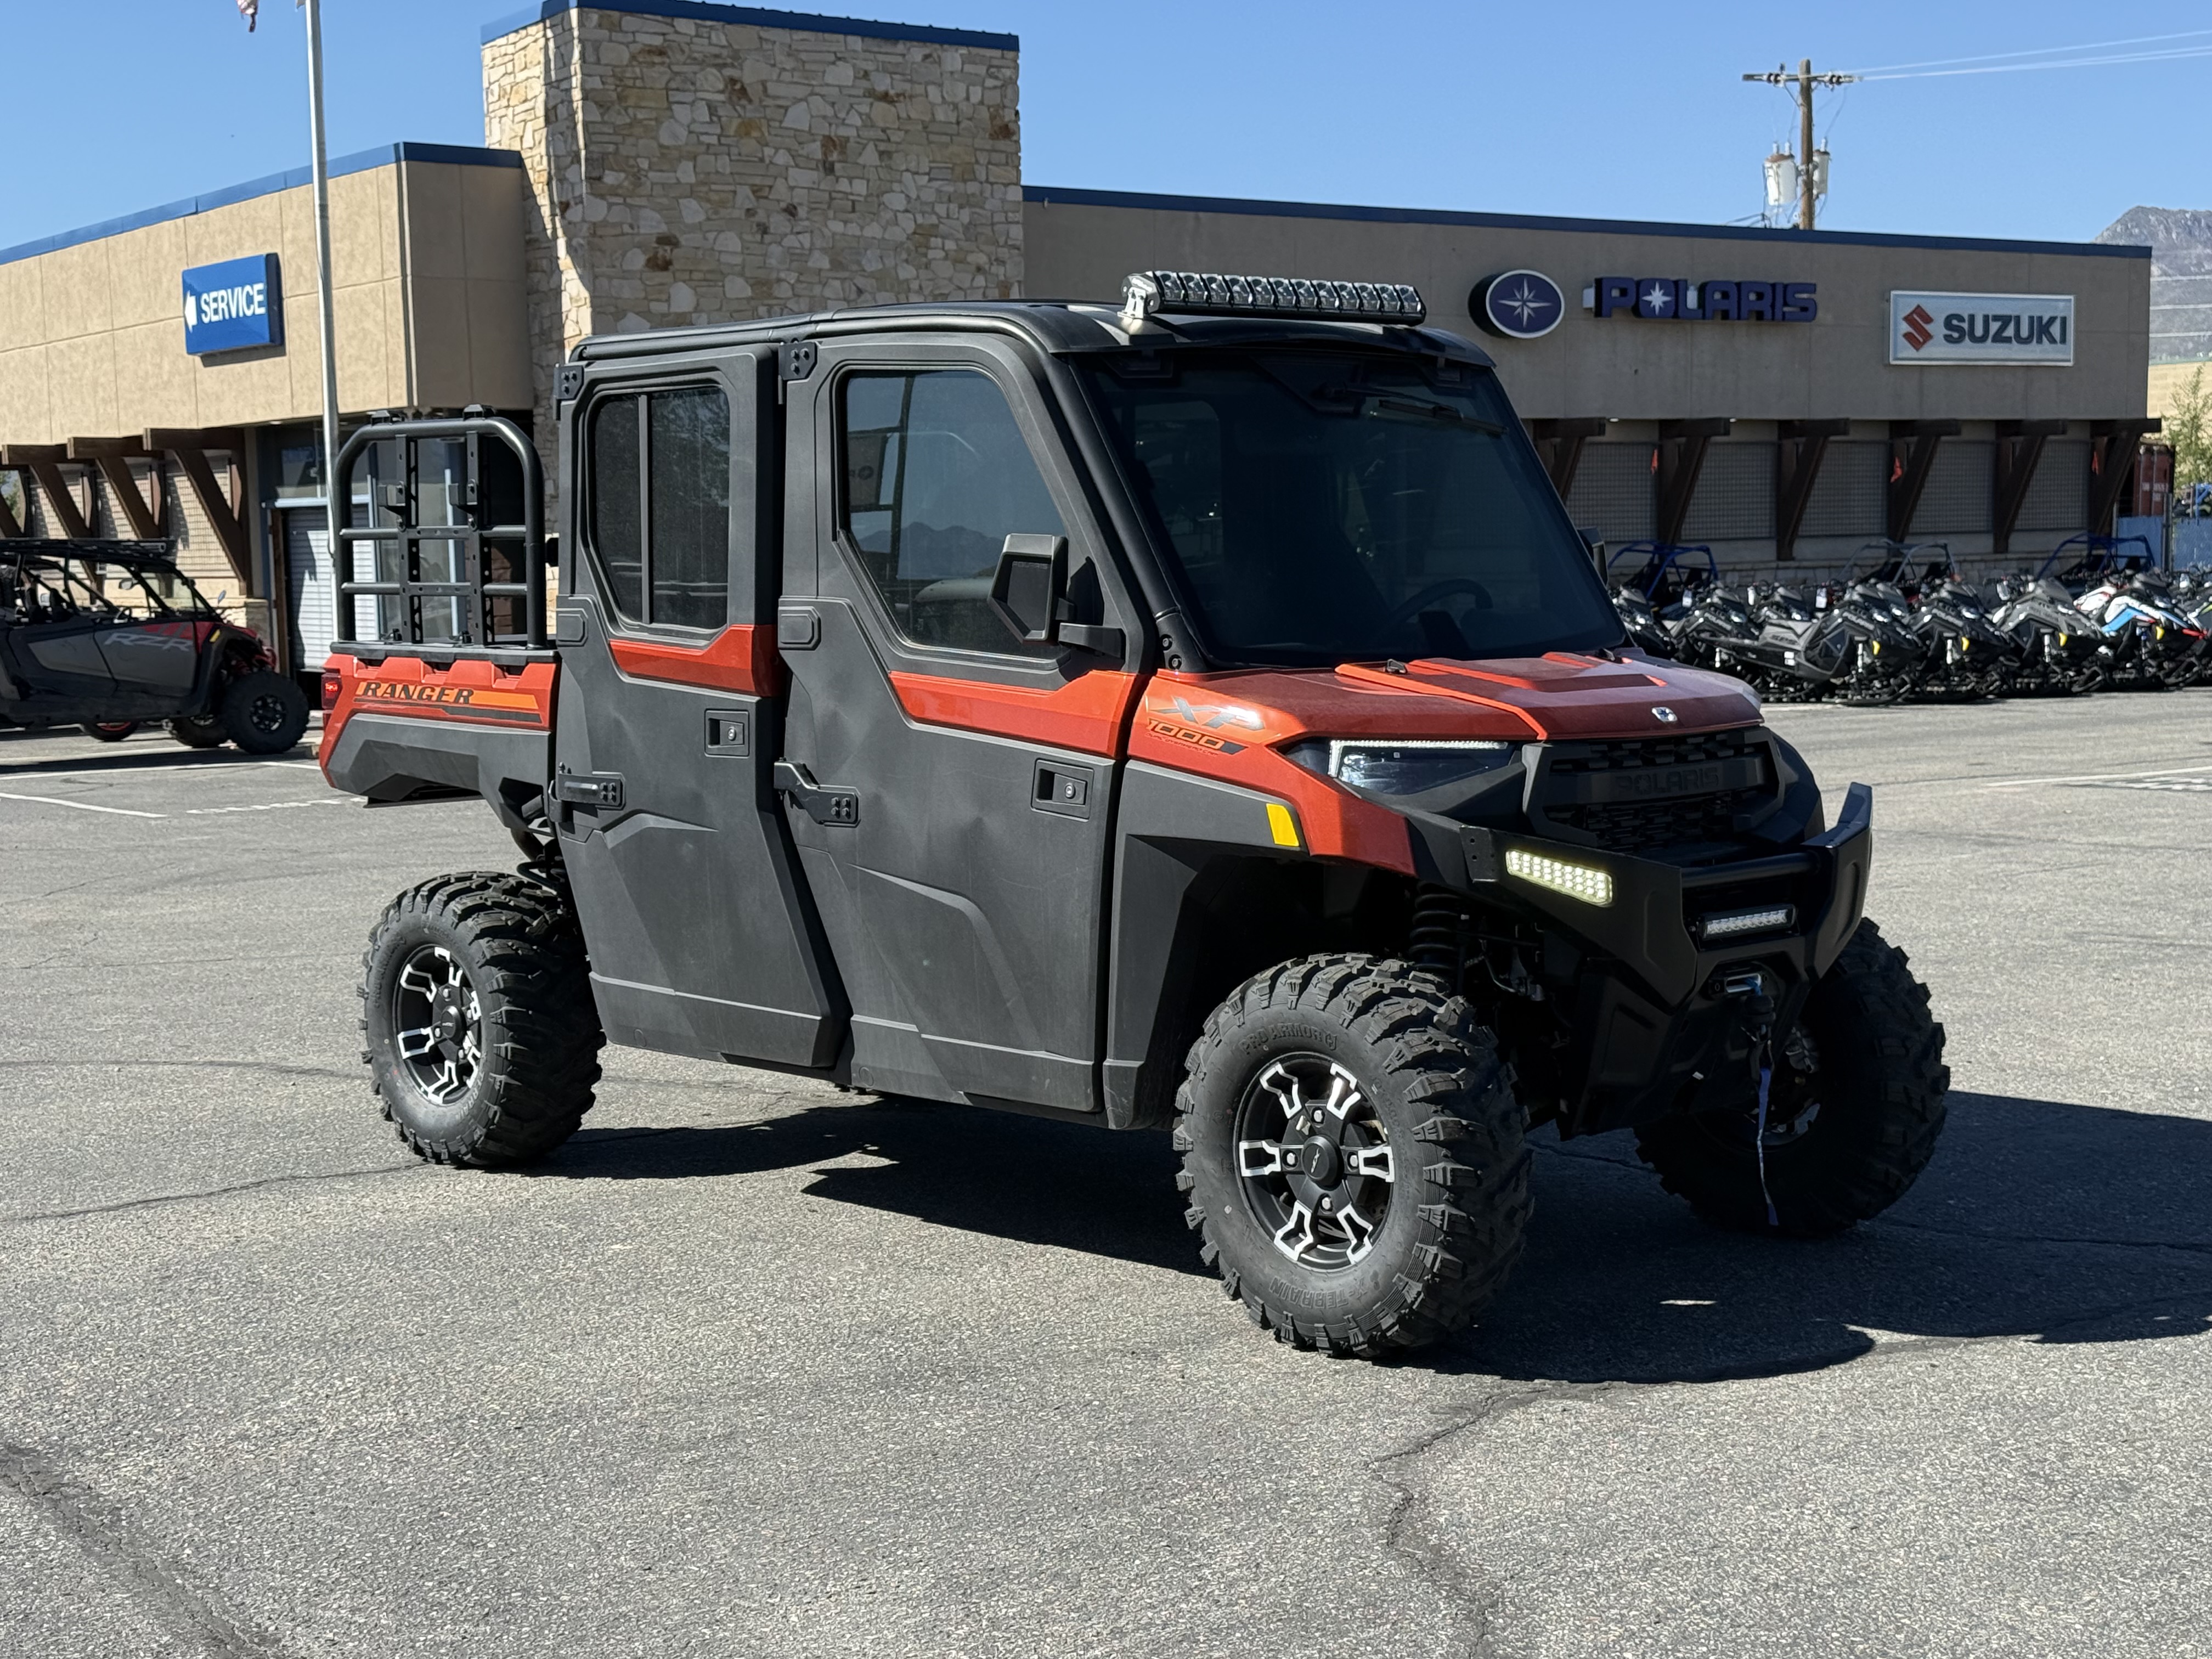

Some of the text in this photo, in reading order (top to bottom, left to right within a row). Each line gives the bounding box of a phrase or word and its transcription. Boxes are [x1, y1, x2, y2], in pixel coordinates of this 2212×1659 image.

[200, 282, 266, 324] SERVICE
[1595, 277, 1817, 322] POLARIS
[1943, 313, 2068, 345] SUZUKI
[104, 632, 193, 652] RZR
[362, 680, 475, 704] RANGER
[1149, 695, 1266, 731] XP
[1146, 719, 1225, 750] 1000
[1616, 767, 1719, 795] POLARIS
[1238, 1022, 1323, 1056] PRO ARMOR
[1268, 1274, 1369, 1310] X-TERRAIN
